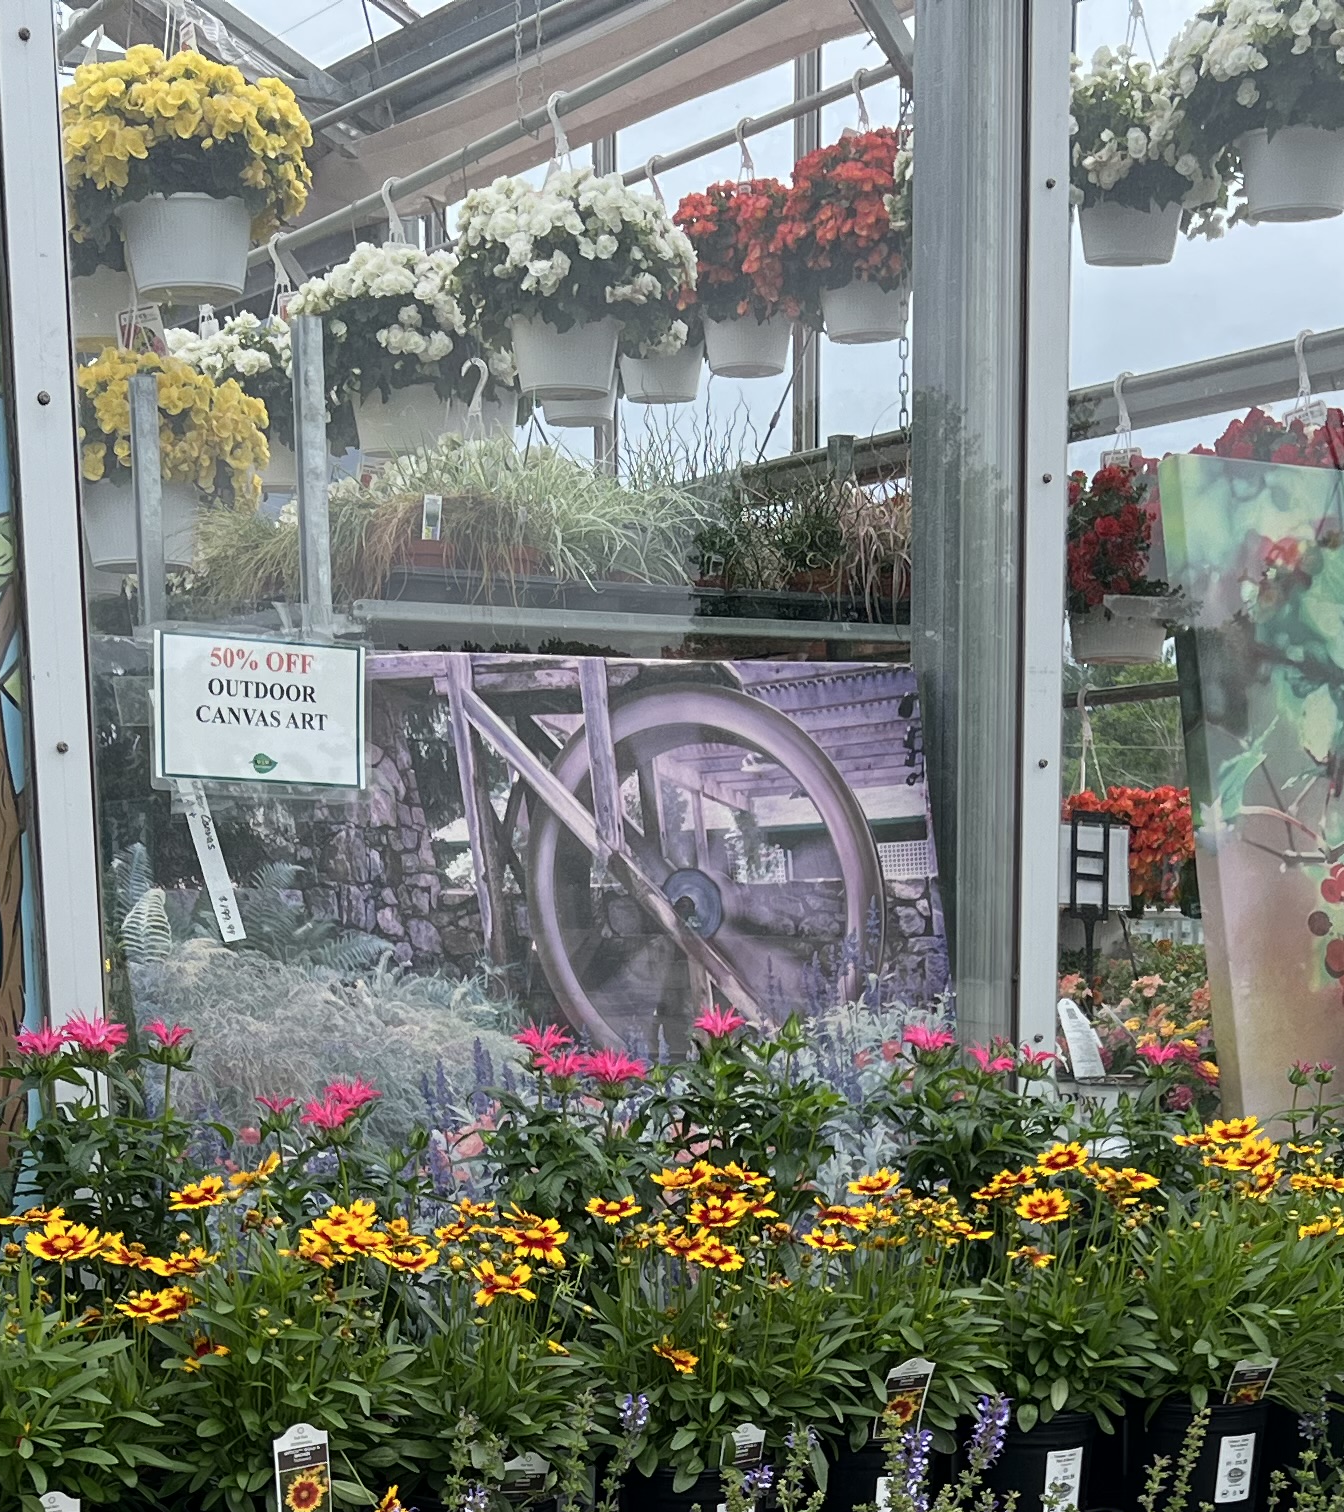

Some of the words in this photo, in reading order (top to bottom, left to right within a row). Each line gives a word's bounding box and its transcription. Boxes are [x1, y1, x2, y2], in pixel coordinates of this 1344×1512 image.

[210, 647, 257, 671] 50%
[266, 651, 314, 674] OFF
[208, 677, 316, 703] OUTDOOR
[196, 705, 281, 728] CANVAS
[286, 711, 328, 731] ART
